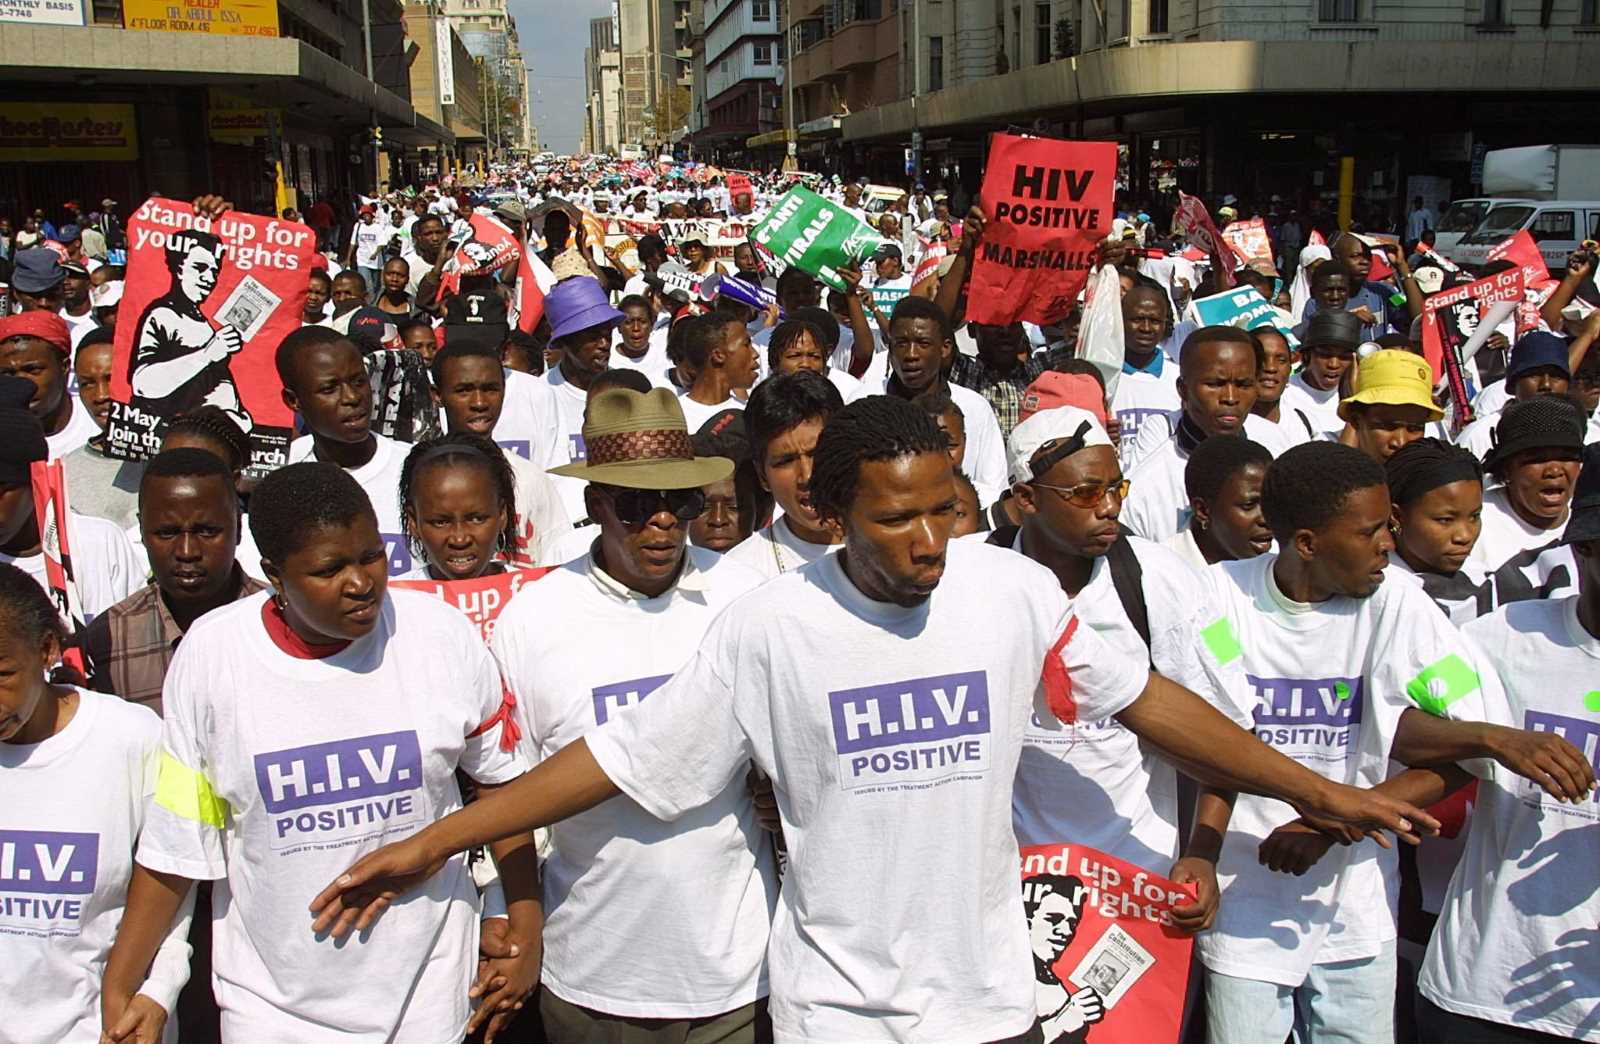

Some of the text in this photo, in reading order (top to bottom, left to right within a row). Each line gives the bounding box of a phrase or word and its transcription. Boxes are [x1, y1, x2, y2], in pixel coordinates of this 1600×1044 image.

[0, 0, 74, 11] ONTHLY BASIS
[170, 20, 194, 31] ROOM
[1012, 164, 1094, 202] HIV
[136, 200, 308, 248] Stand up for
[994, 202, 1099, 230] POSITIVE
[133, 227, 299, 270] your rights
[784, 208, 834, 266] VIRALS
[981, 242, 1097, 270] MARSHALLS
[1425, 272, 1519, 311] Stand up for
[1474, 286, 1518, 309] rights
[107, 422, 161, 448] Join th
[112, 403, 121, 419] 2
[124, 407, 161, 432] May
[458, 588, 500, 619] up
[843, 685, 979, 741] H.I.V.
[267, 745, 410, 802] H.I.V.
[852, 741, 980, 777] POSITIVE
[934, 779, 951, 787] ACTION
[276, 795, 413, 838] POSITIVE
[1, 842, 83, 882] I.V.
[326, 839, 361, 849] TREATMENT
[1020, 848, 1185, 905] nd up for
[1073, 882, 1172, 926] rights
